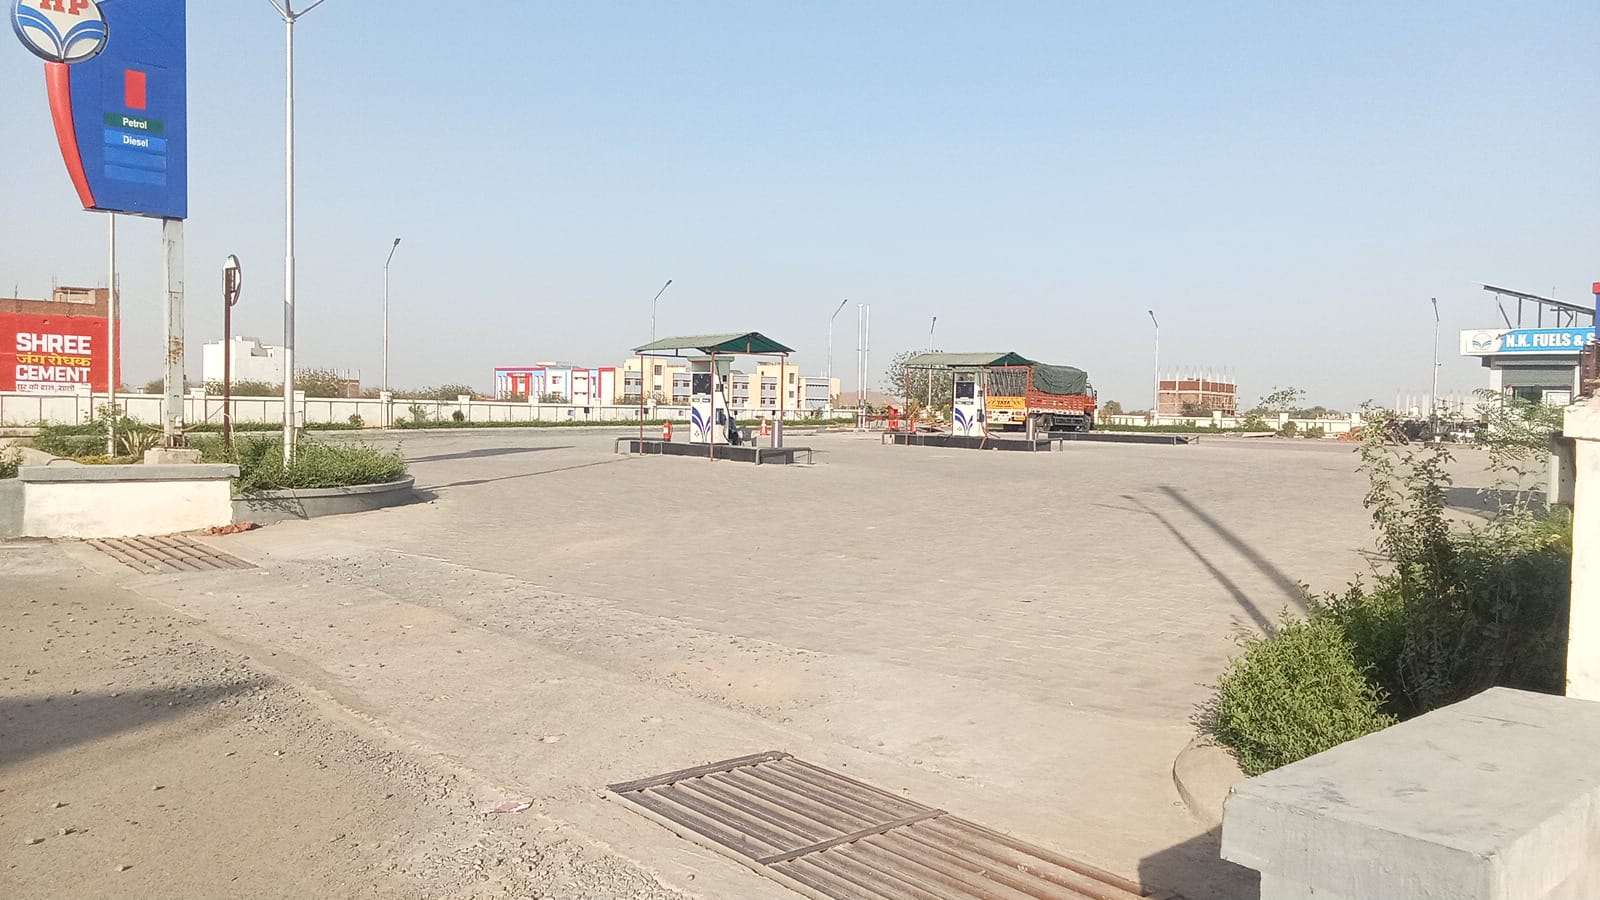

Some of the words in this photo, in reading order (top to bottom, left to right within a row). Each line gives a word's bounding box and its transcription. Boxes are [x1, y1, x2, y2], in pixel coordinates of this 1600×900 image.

[122, 117, 148, 130] Petrol
[123, 135, 149, 148] Diesel
[16, 332, 92, 355] SHREE
[1505, 334, 1531, 348] N.K.
[1533, 332, 1571, 347] FUELS
[1573, 334, 1584, 347] &
[1586, 332, 1596, 345] S
[16, 352, 46, 365] जंग
[16, 364, 91, 382] CEMENT
